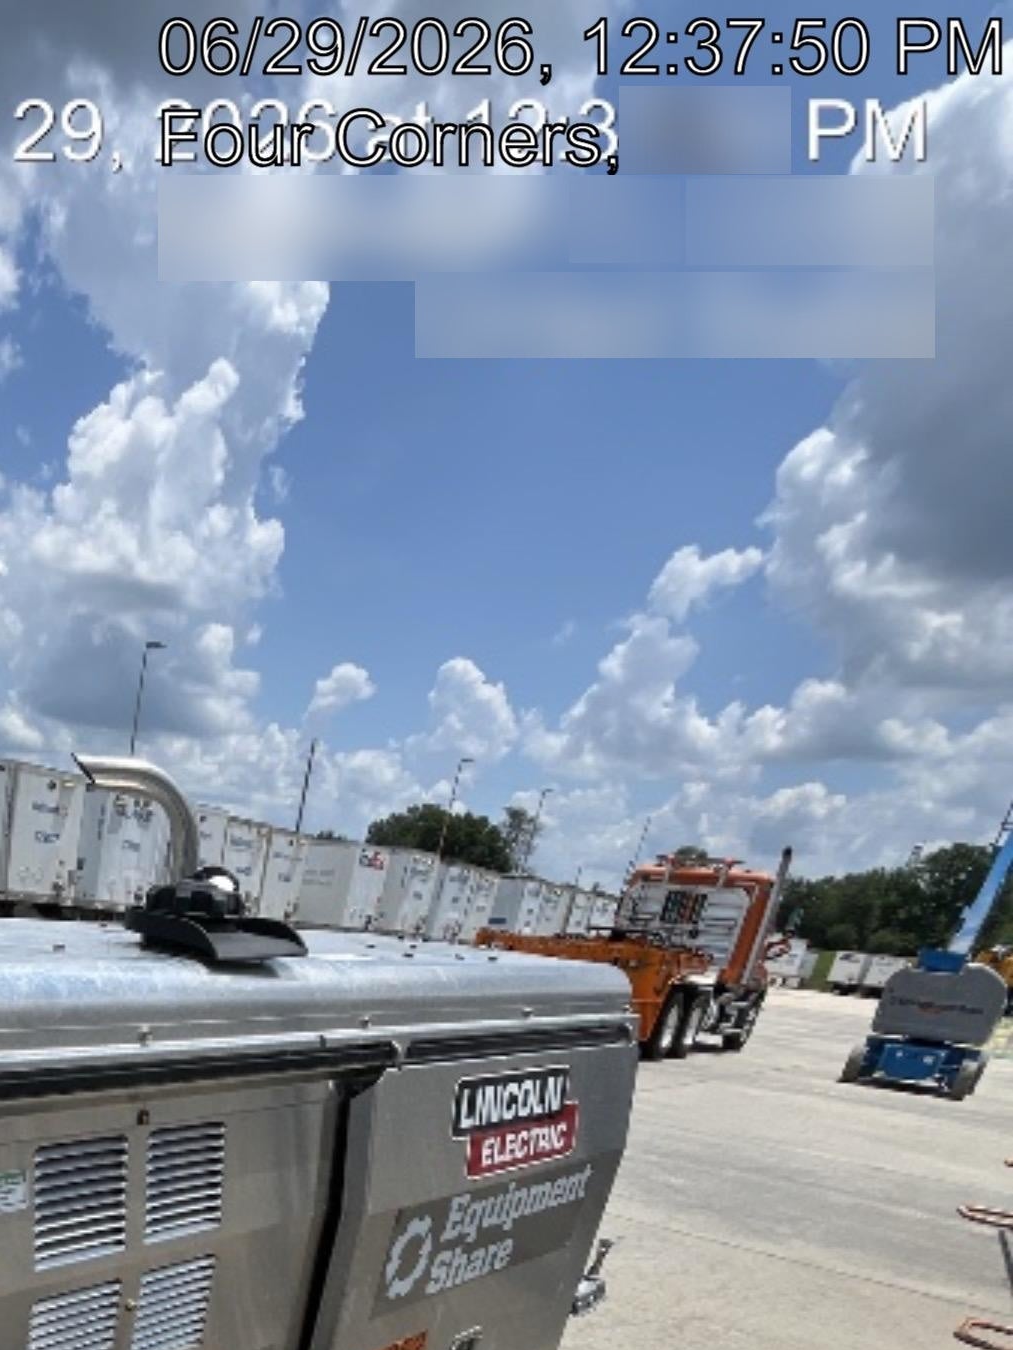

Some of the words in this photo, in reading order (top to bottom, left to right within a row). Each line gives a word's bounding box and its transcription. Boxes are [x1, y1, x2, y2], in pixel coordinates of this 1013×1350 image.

[459, 1075, 565, 1130] LINCOLN
[481, 1121, 568, 1168] ELECTRIC
[440, 1162, 594, 1244] Equipment
